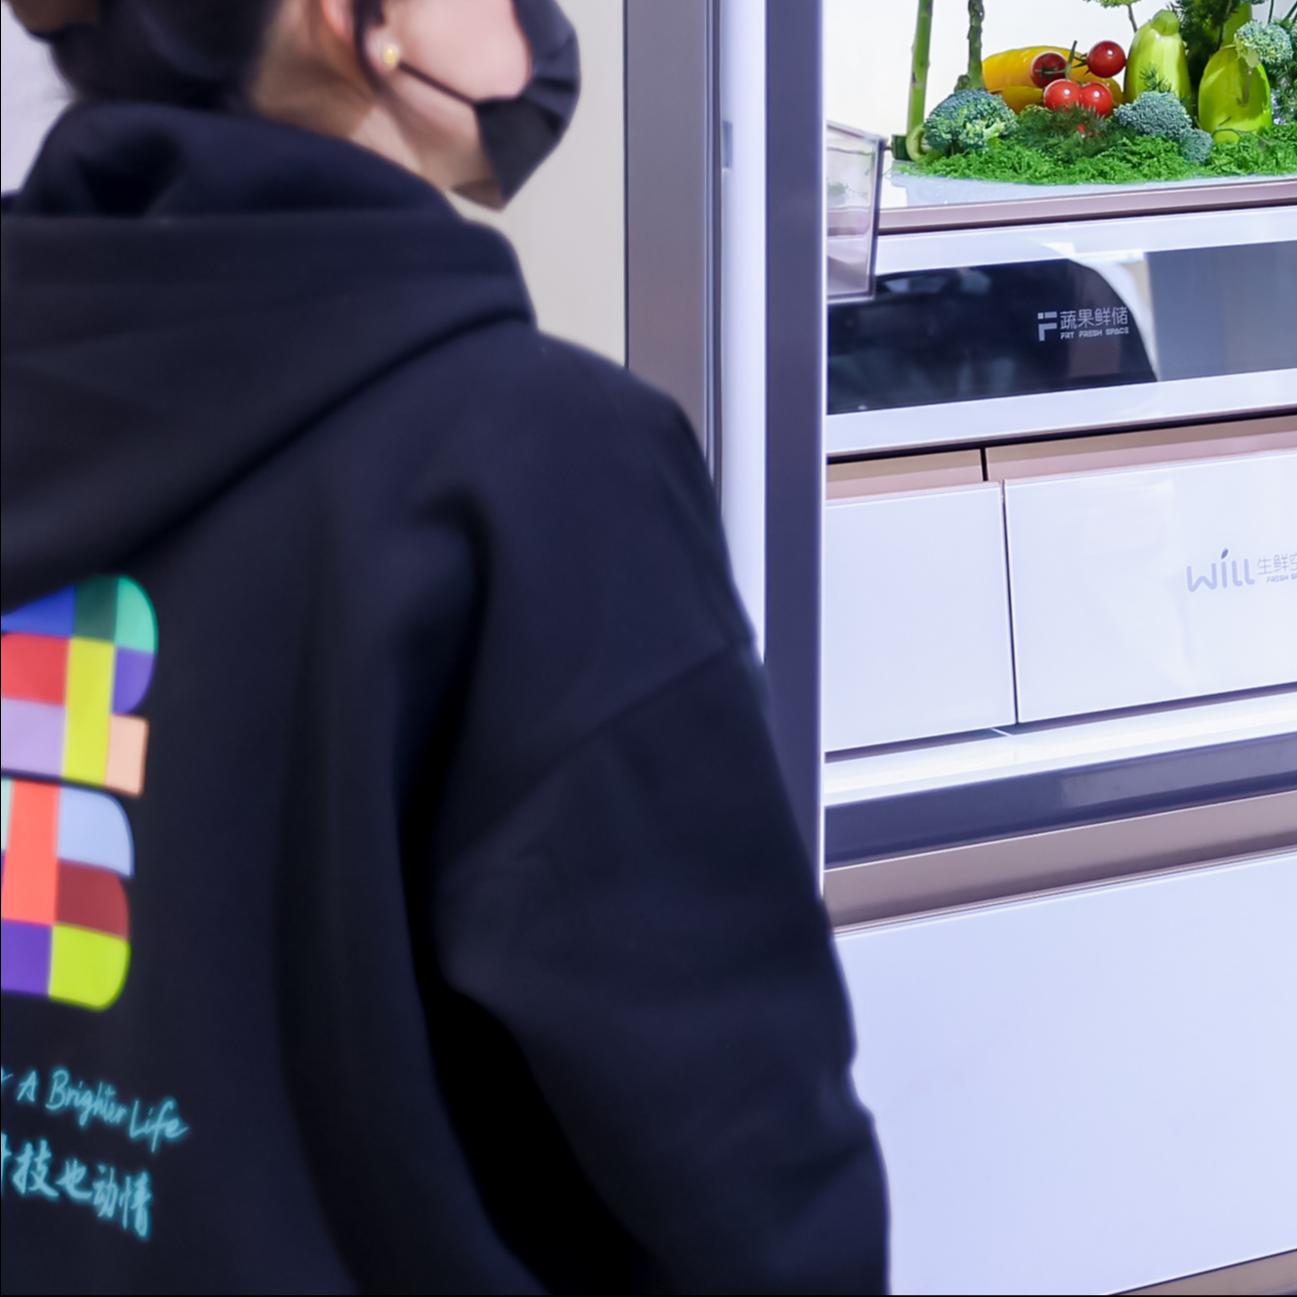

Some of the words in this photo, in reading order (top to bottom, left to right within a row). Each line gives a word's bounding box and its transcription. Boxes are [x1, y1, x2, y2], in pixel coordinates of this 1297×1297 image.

[1060, 306, 1128, 330] 蔬果鲜储
[128, 1096, 189, 1153] Life
